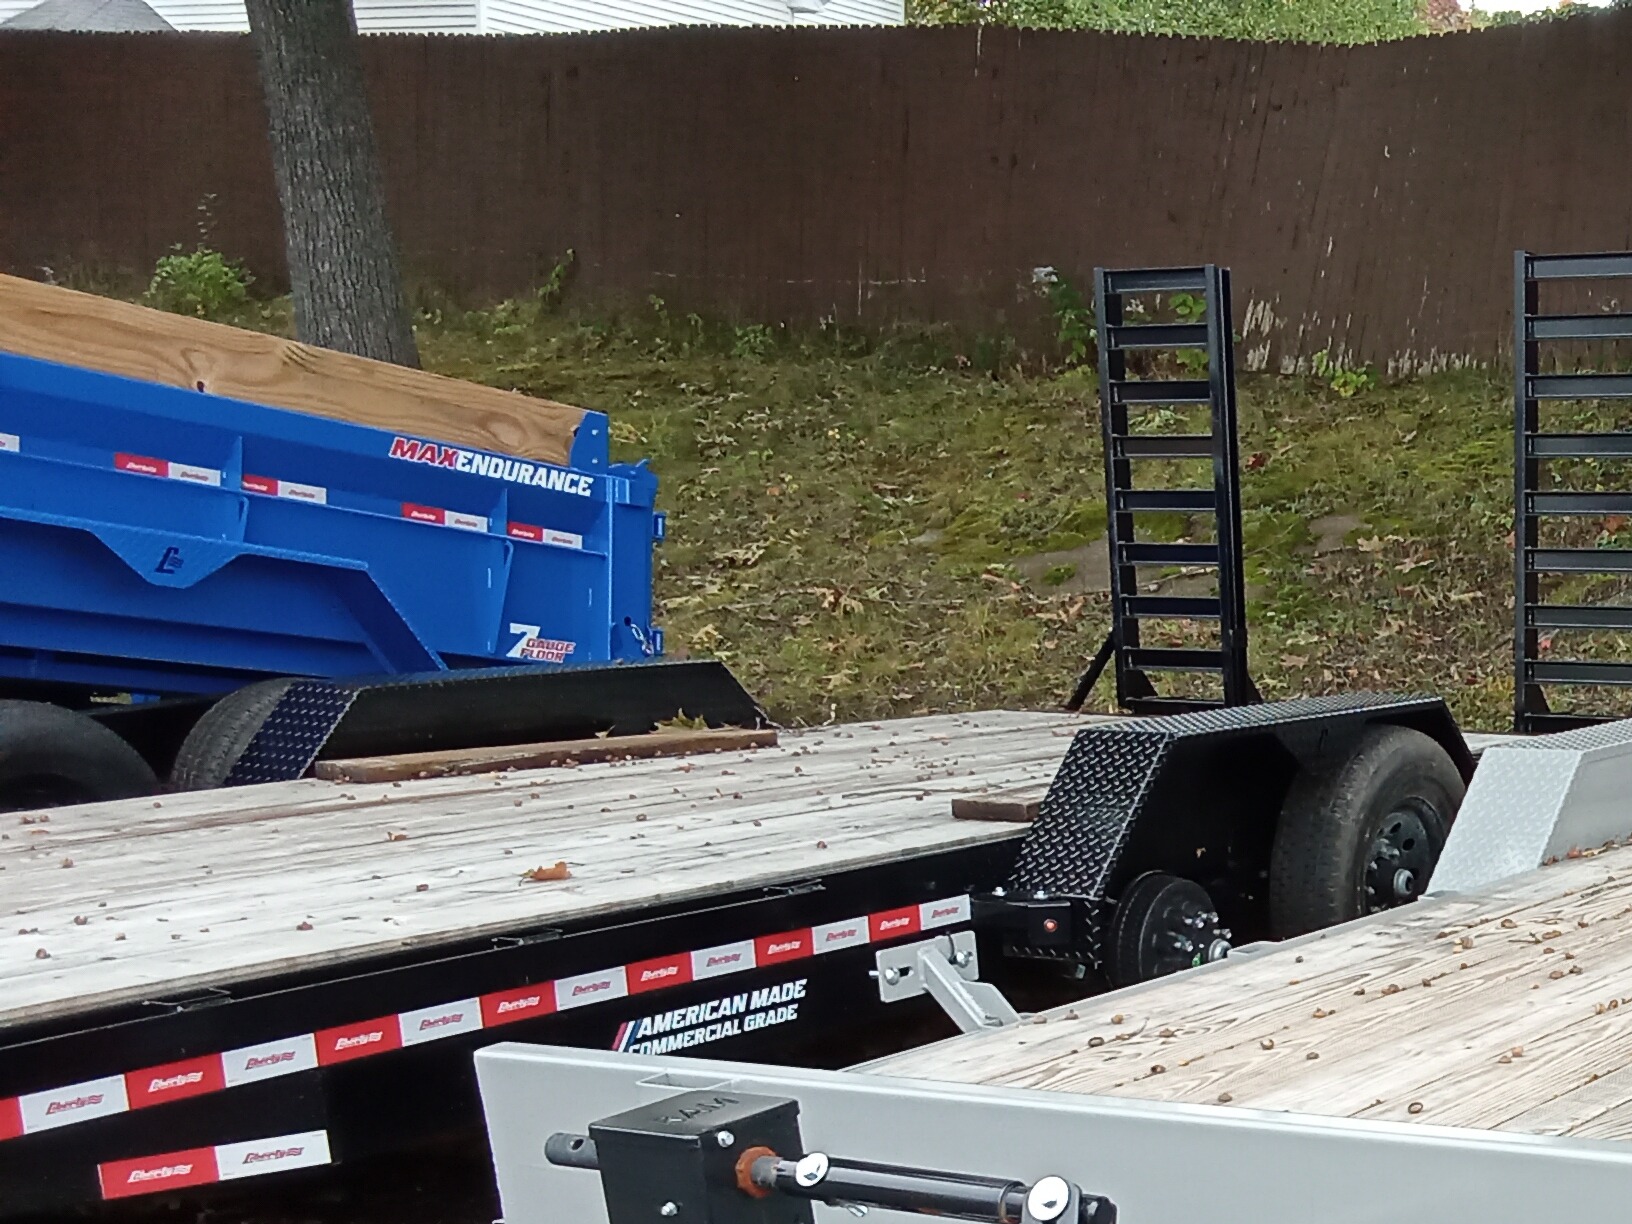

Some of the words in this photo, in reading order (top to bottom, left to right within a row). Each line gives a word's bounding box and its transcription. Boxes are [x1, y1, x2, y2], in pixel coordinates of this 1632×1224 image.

[388, 437, 594, 497] MAXENDURANCE
[506, 622, 541, 659] 7
[520, 648, 565, 663] FLOOR
[526, 638, 576, 654] GAUGE
[629, 1019, 742, 1056] COMMERCIAL
[743, 1004, 799, 1032] GRADE
[636, 993, 748, 1039] AMERICAN
[750, 979, 808, 1011] MADE
